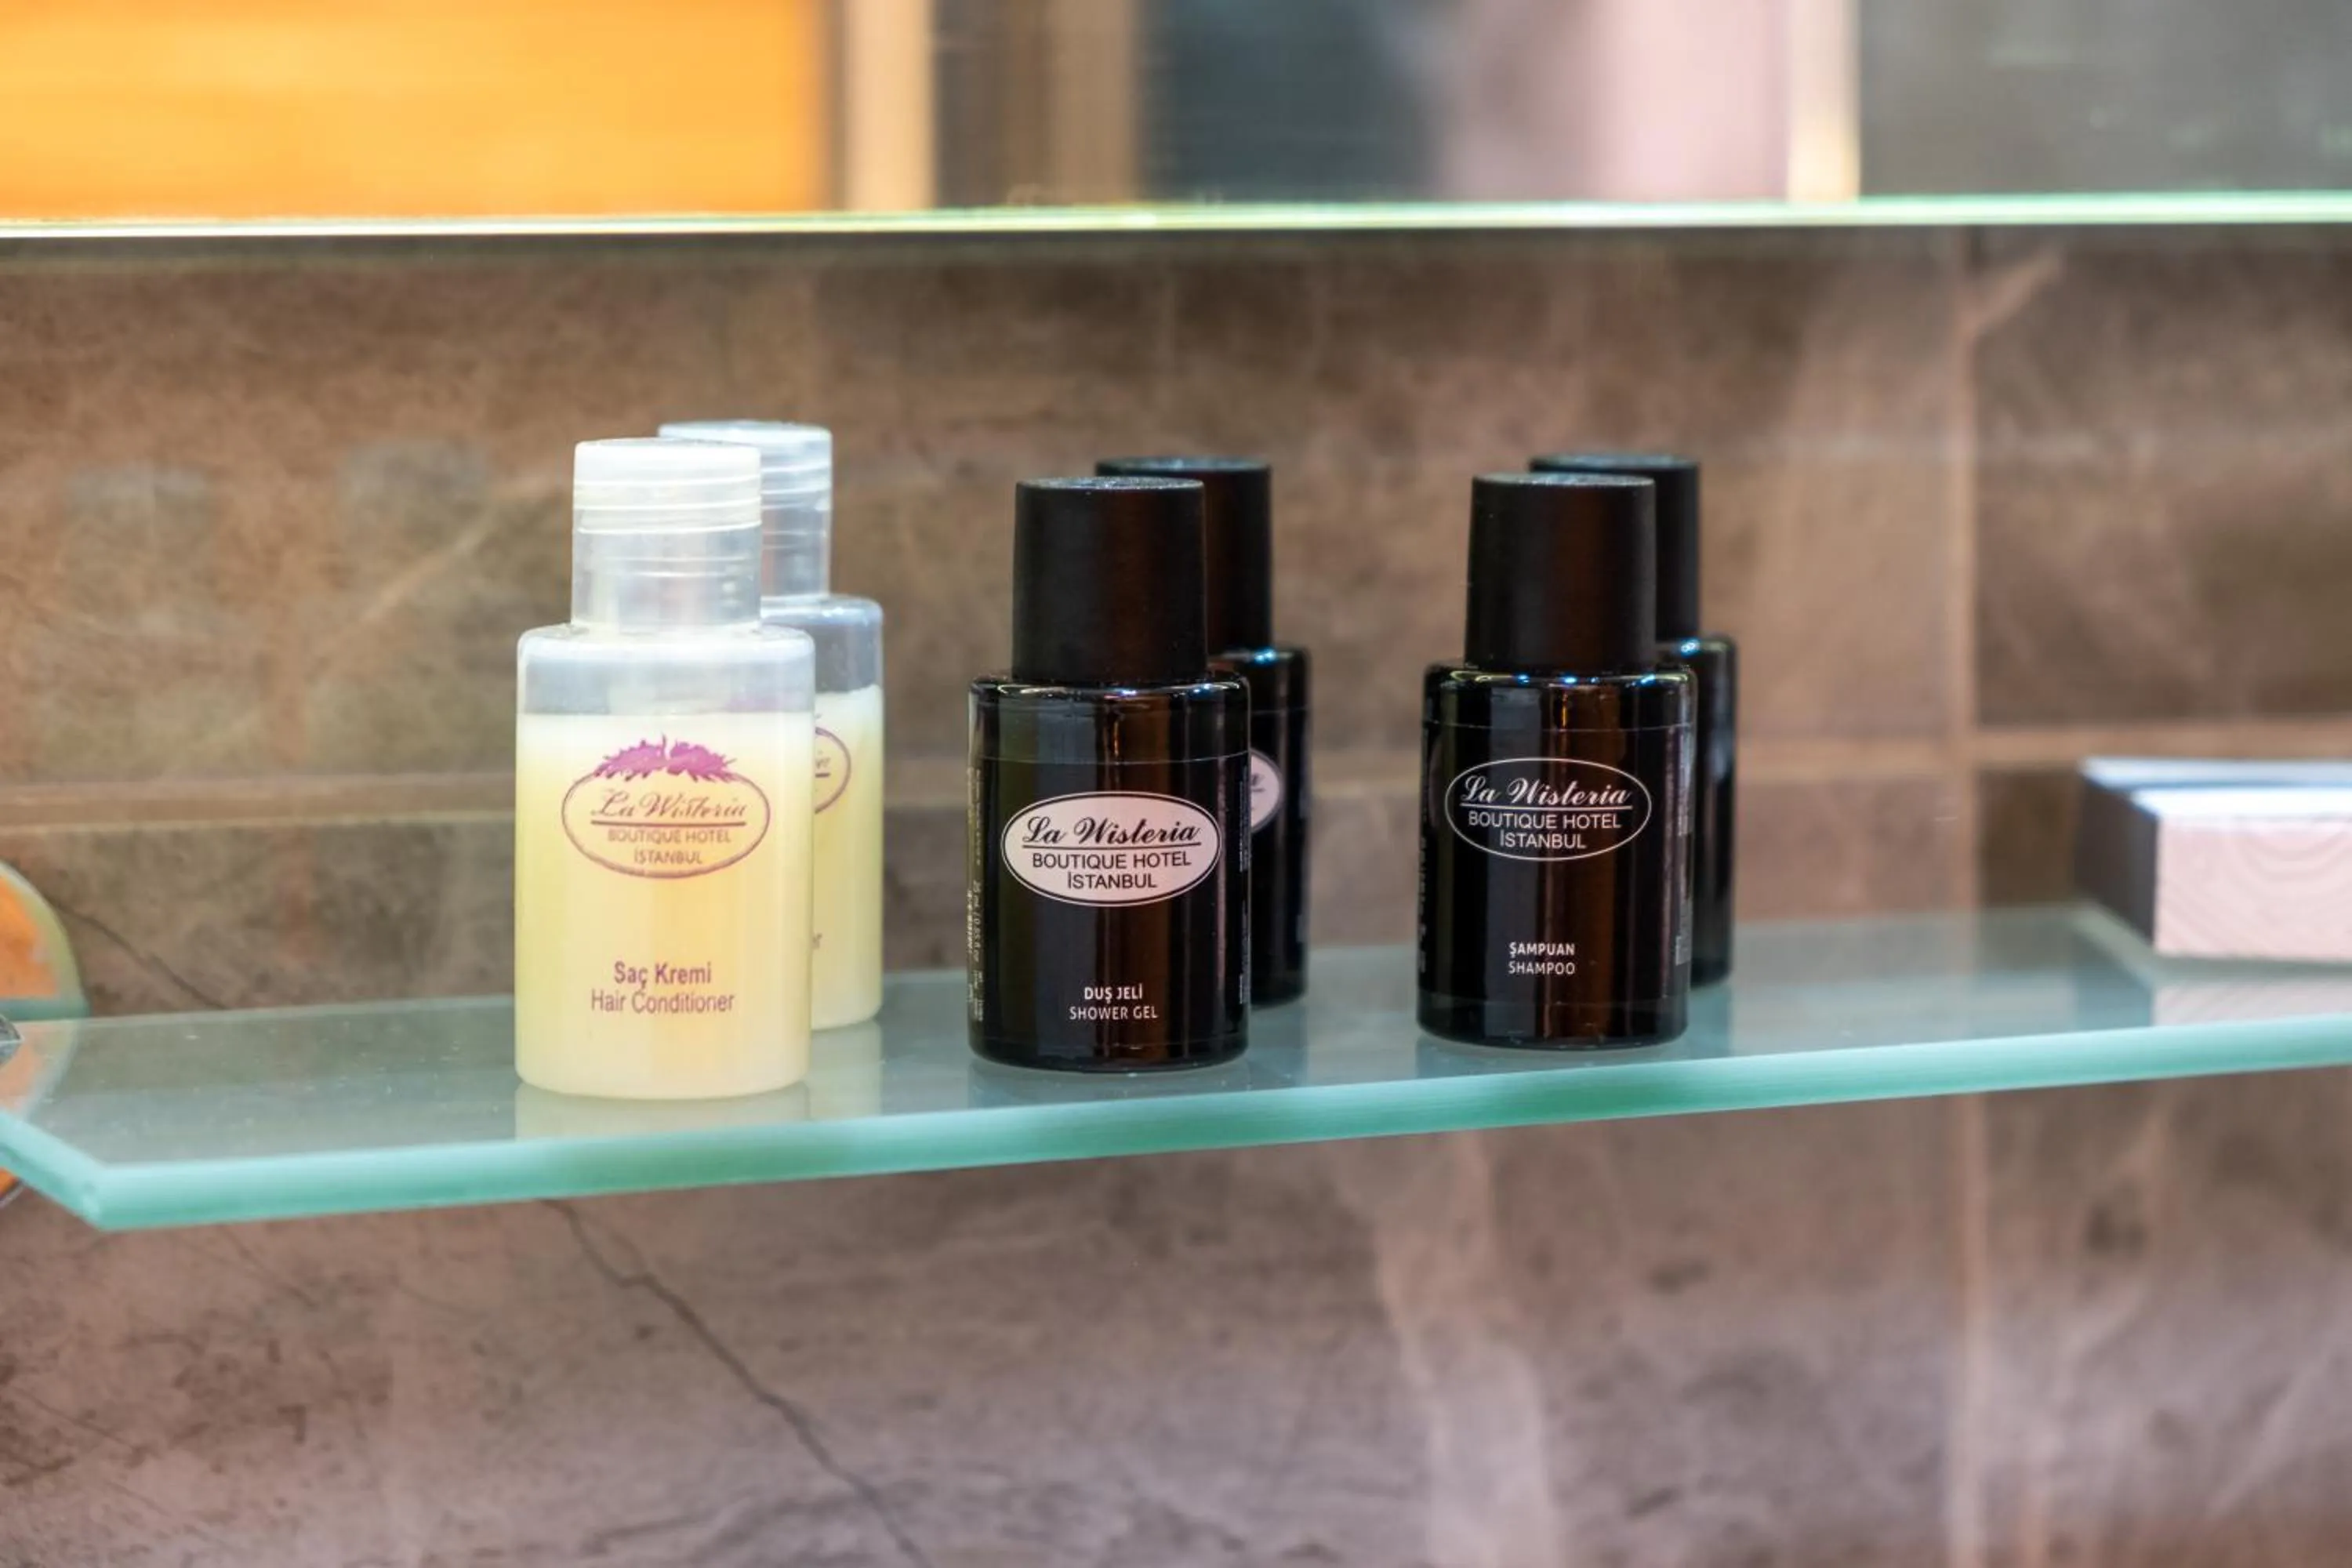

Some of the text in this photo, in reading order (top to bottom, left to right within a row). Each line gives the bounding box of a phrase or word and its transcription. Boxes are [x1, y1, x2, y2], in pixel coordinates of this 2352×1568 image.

[1461, 775, 1633, 806] La Wisteria
[591, 789, 633, 817] La
[1468, 811, 1621, 829] BOUTIQUE HOTEL
[608, 828, 731, 844] BOUTIQUE HOTEL
[1022, 816, 1201, 845] La Wisteria
[1033, 851, 1192, 869] BOUTIQUE HOTEL
[1508, 942, 1575, 958] ŞAMPUAN
[614, 960, 712, 989] Saç Kremi
[1508, 960, 1576, 975] SHAMPOO
[591, 989, 735, 1014] Hair Conditioner
[1084, 984, 1143, 1004] DUŞ JELİ
[1069, 1005, 1158, 1020] SHOWER GEL
